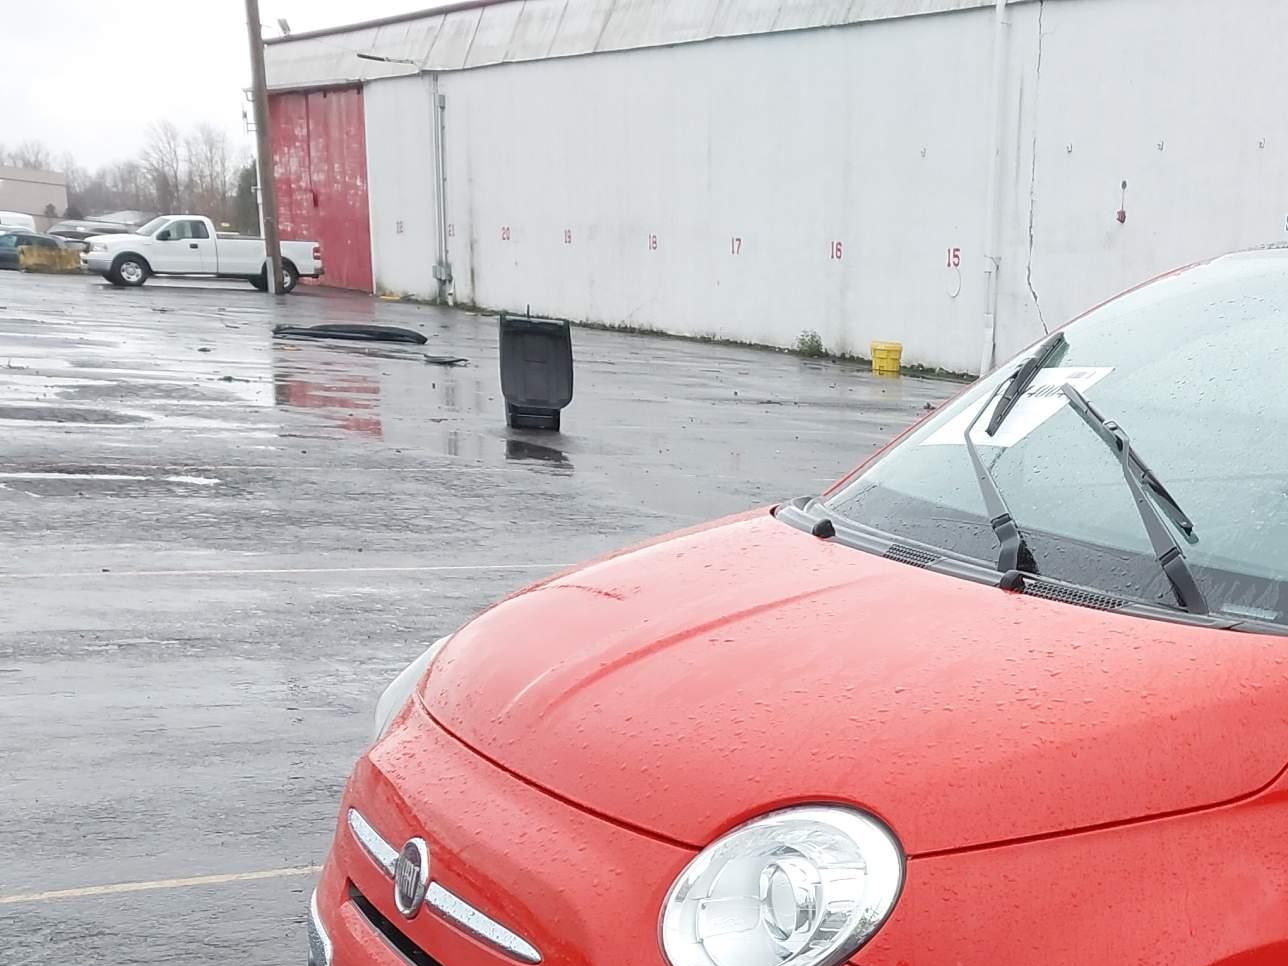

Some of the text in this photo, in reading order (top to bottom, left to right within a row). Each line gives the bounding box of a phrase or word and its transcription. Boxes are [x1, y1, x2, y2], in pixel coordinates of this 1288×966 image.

[648, 234, 658, 250] 18
[731, 237, 742, 255] 17
[830, 241, 842, 259] 16
[946, 248, 961, 268] 15
